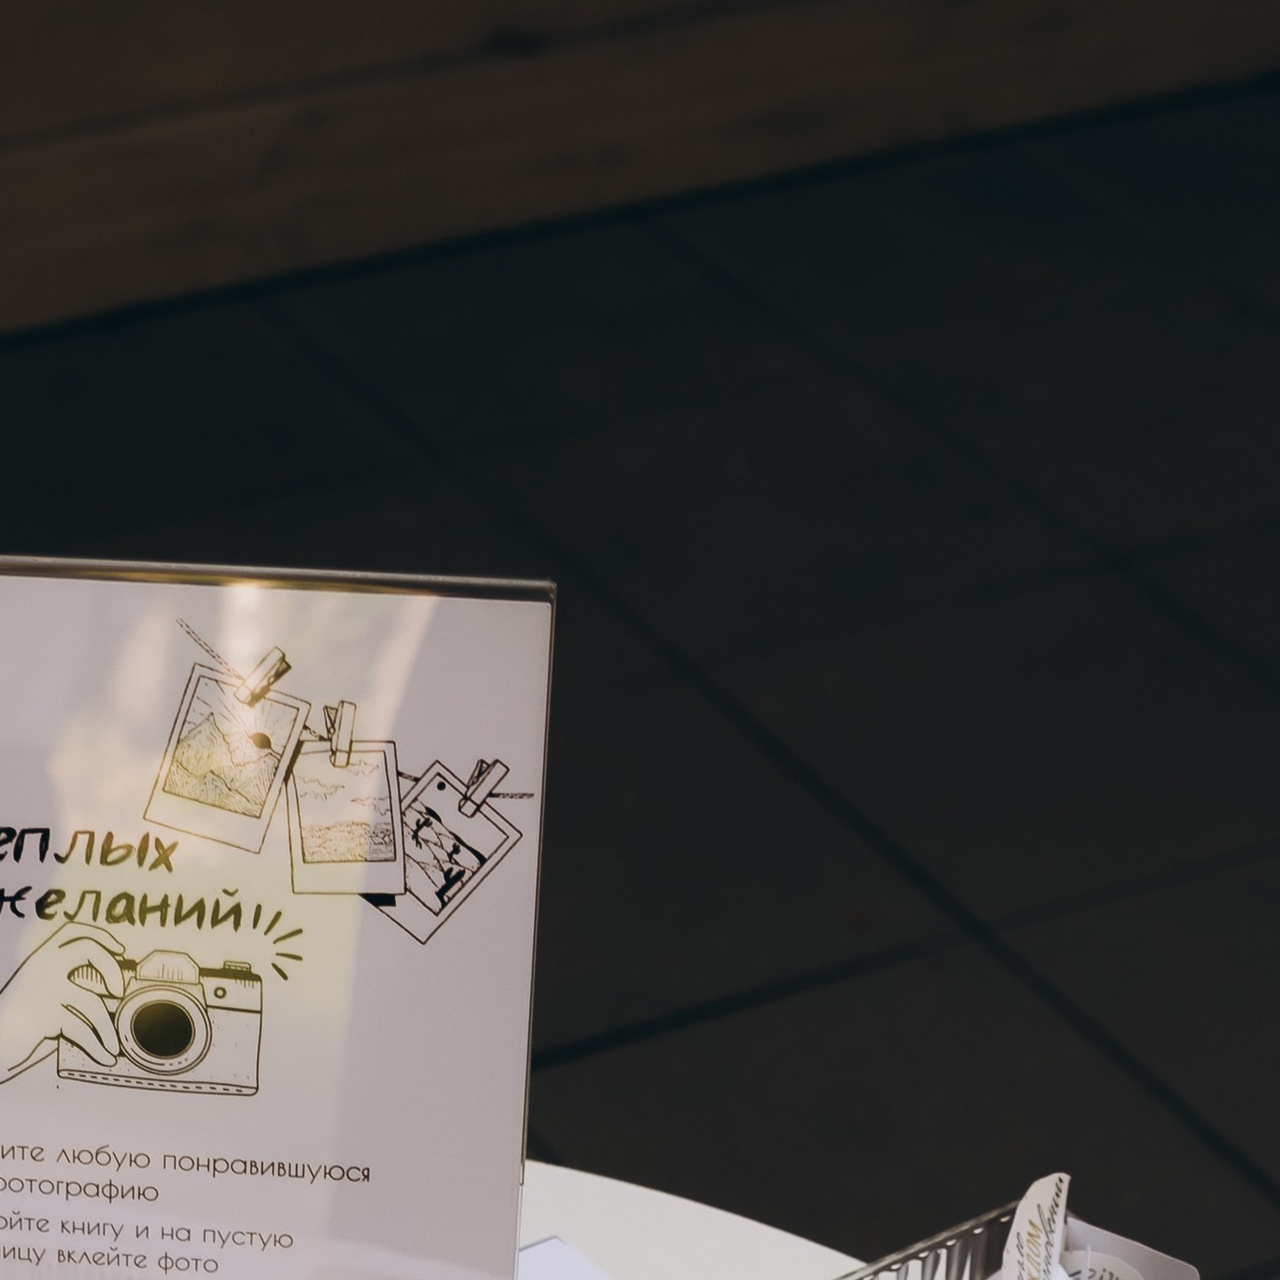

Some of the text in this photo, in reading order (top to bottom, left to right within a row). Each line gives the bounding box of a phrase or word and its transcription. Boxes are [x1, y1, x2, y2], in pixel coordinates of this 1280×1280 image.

[57, 1143, 151, 1171] любую
[163, 1151, 371, 1184] понравившуюся
[60, 1217, 124, 1242] книгу
[135, 1224, 149, 1239] и
[161, 1226, 192, 1243] на
[203, 1227, 294, 1251] пустую
[57, 1246, 148, 1270] вклейте
[157, 1249, 219, 1276] фото
